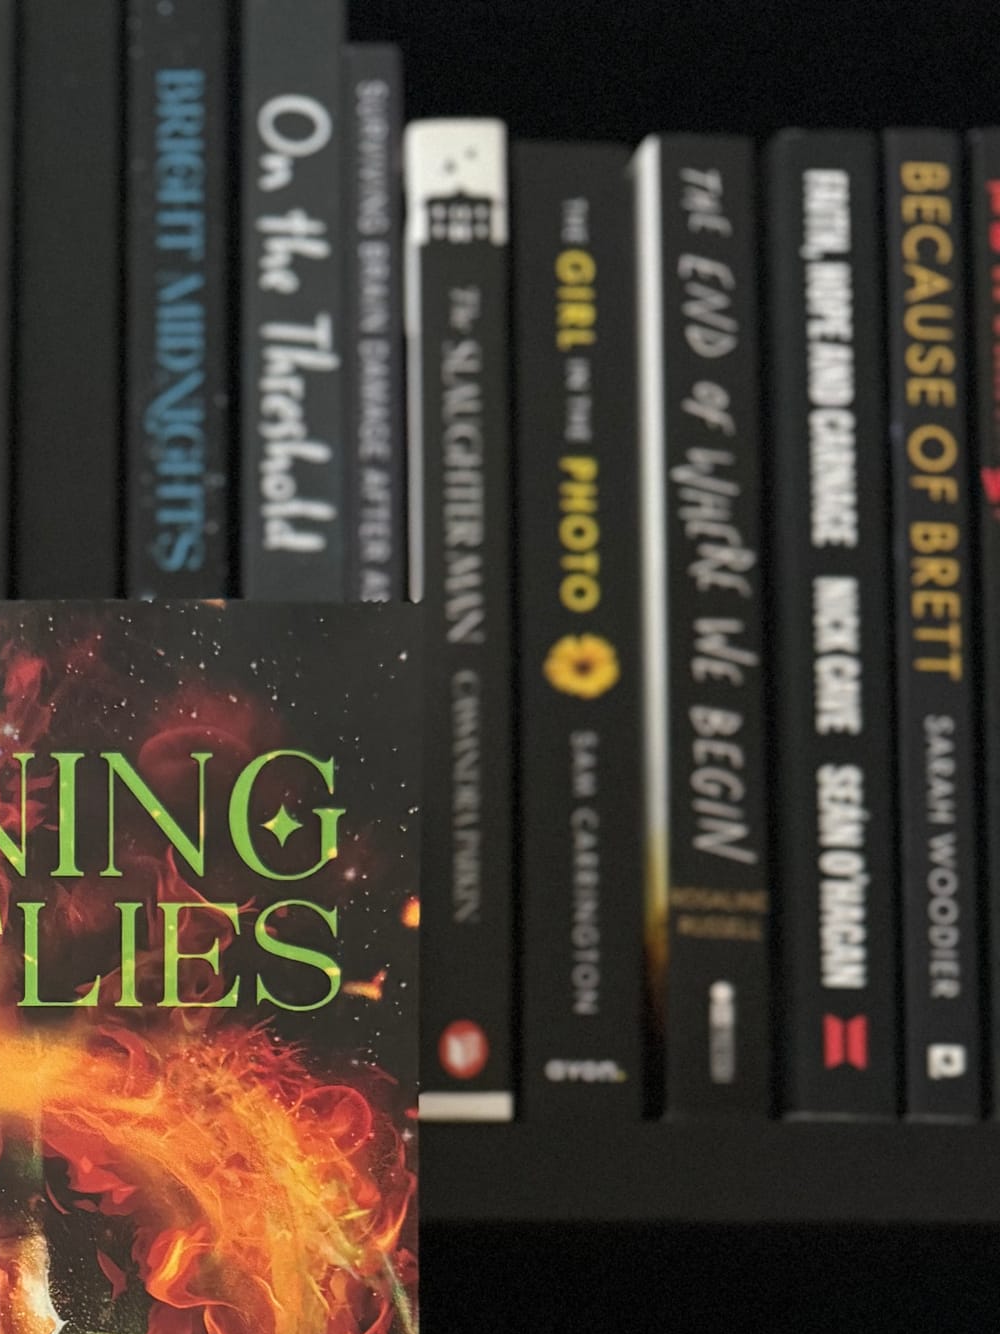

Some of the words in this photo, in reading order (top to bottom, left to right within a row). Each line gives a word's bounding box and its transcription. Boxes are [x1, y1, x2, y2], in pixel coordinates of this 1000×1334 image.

[155, 69, 204, 260] BRIGHT
[258, 94, 332, 192] On
[355, 79, 389, 236] SURVIVING
[255, 211, 331, 294] the
[680, 167, 731, 236] THE
[357, 242, 390, 333] BRAIN
[555, 250, 595, 351] GIRL
[677, 254, 737, 357] END
[805, 262, 852, 340] HOPE
[901, 161, 956, 409] BECAUSE
[144, 273, 206, 573] MIDNIGHTS
[357, 339, 390, 462] DAMAGE
[809, 342, 854, 408] AND
[259, 312, 339, 552] Threshold
[808, 409, 858, 548] CARNAGE
[907, 424, 959, 504] OF
[359, 468, 391, 562] AFTER
[558, 456, 599, 613] PHOTO
[670, 448, 755, 597] WHERE
[690, 617, 759, 686] WE
[812, 577, 859, 652] NICK
[909, 522, 961, 681] BRETT
[814, 656, 863, 735] CAVE
[570, 730, 597, 796] SAM
[689, 706, 757, 864] BEGIN
[923, 714, 956, 824] SARAH
[570, 807, 598, 1016] CARRINGTON
[927, 833, 961, 999] WOODIER
